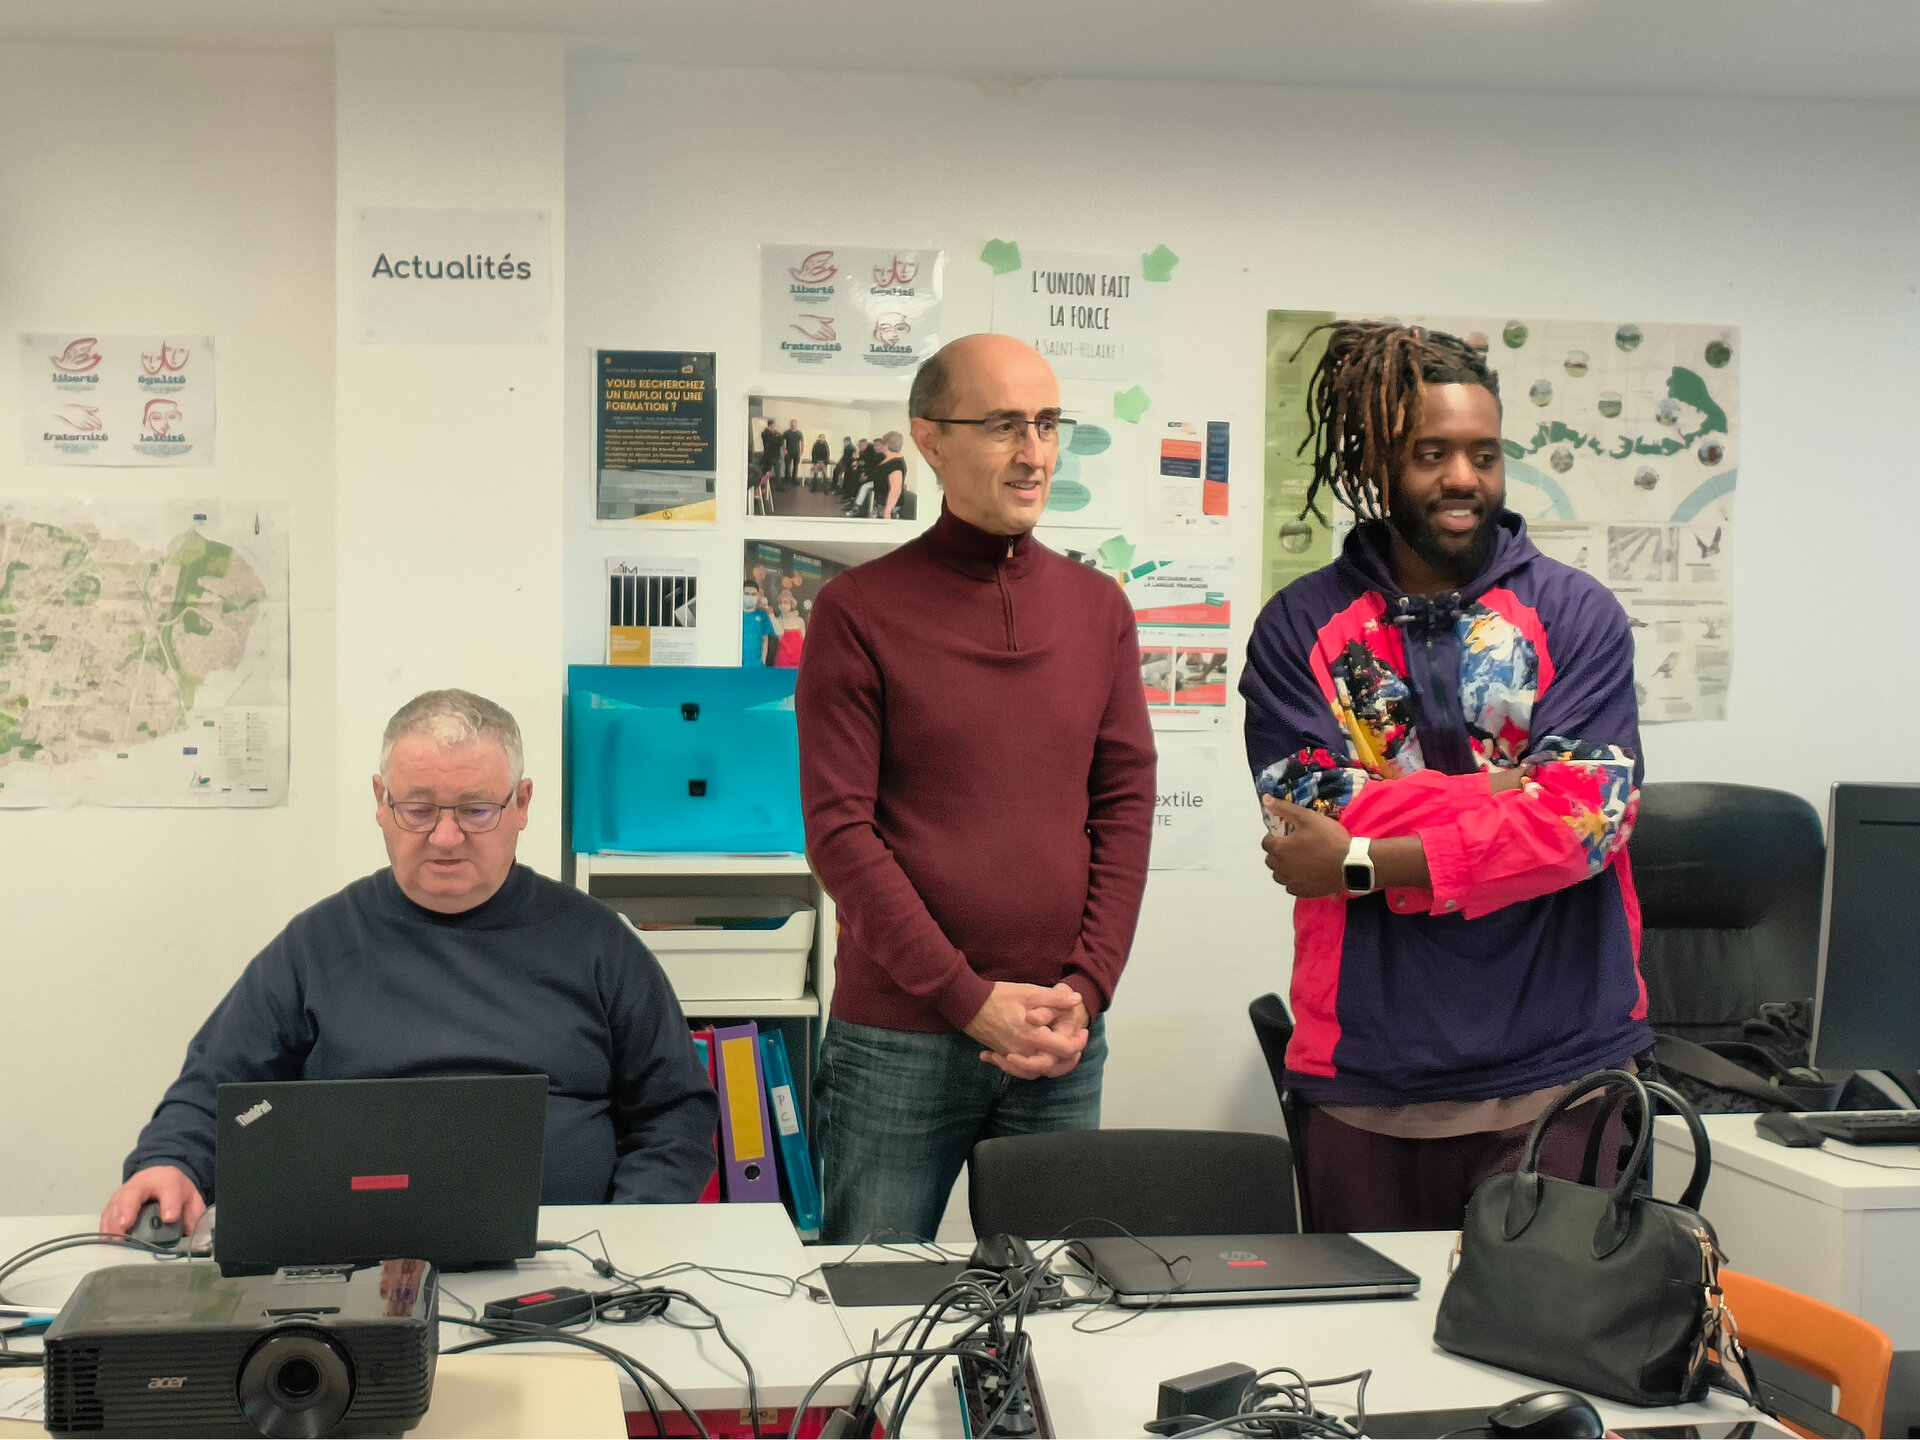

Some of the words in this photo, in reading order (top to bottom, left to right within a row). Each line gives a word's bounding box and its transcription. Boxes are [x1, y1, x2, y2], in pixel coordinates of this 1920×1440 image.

[372, 253, 532, 280] Actualités
[790, 284, 835, 295] liberté
[1032, 270, 1096, 296] L'UNION
[1101, 274, 1131, 298] FAIT
[1049, 304, 1065, 327] LA
[1071, 305, 1110, 330] FORCE
[781, 341, 841, 352] fraternité
[52, 373, 99, 383] liberté
[138, 374, 186, 385] égalité
[606, 379, 637, 389] VOUS
[639, 380, 705, 389] RECHERCHEZ
[606, 390, 621, 399] UN
[623, 391, 662, 400] EMPLOI
[664, 391, 681, 400] OU
[682, 392, 703, 401] UNE
[605, 401, 669, 411] FORMATION
[671, 402, 677, 412] ?
[43, 432, 108, 441] fraternité
[147, 1376, 188, 1390] acer
